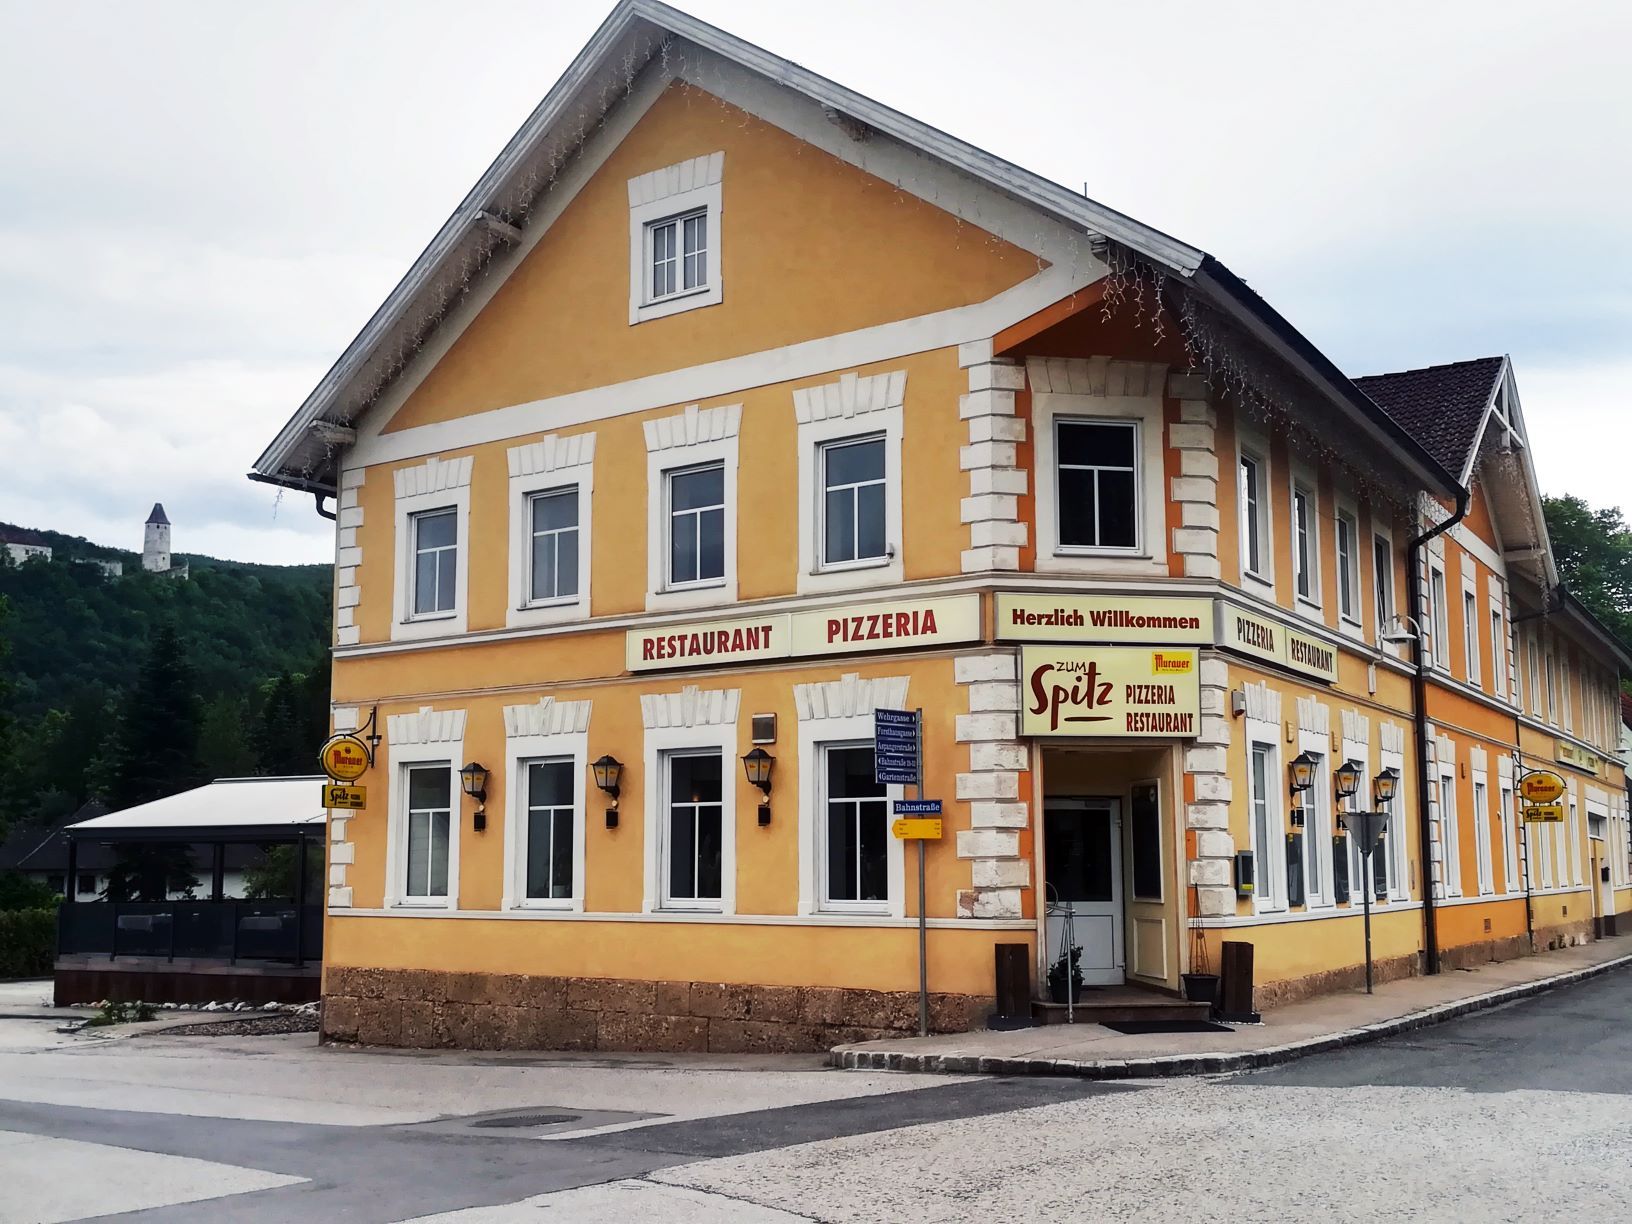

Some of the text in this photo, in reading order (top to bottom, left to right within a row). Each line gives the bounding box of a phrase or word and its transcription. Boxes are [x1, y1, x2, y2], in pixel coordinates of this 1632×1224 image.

[827, 608, 938, 644] PIZZERIA
[1012, 608, 1200, 629] Herzlich Willkommen
[642, 625, 773, 661] RESTAURANT
[1236, 616, 1275, 653] PIZZERIA
[1154, 654, 1190, 671] Murauer
[1290, 637, 1333, 673] RESTAURANT
[1029, 661, 1114, 732] Spitz
[1126, 684, 1176, 705] PIZZERIA
[877, 711, 910, 722] Wehrgasse
[1126, 712, 1194, 733] RESTAURANT
[881, 772, 916, 782] Gartenstraße
[895, 802, 940, 812] Bahnstraße
